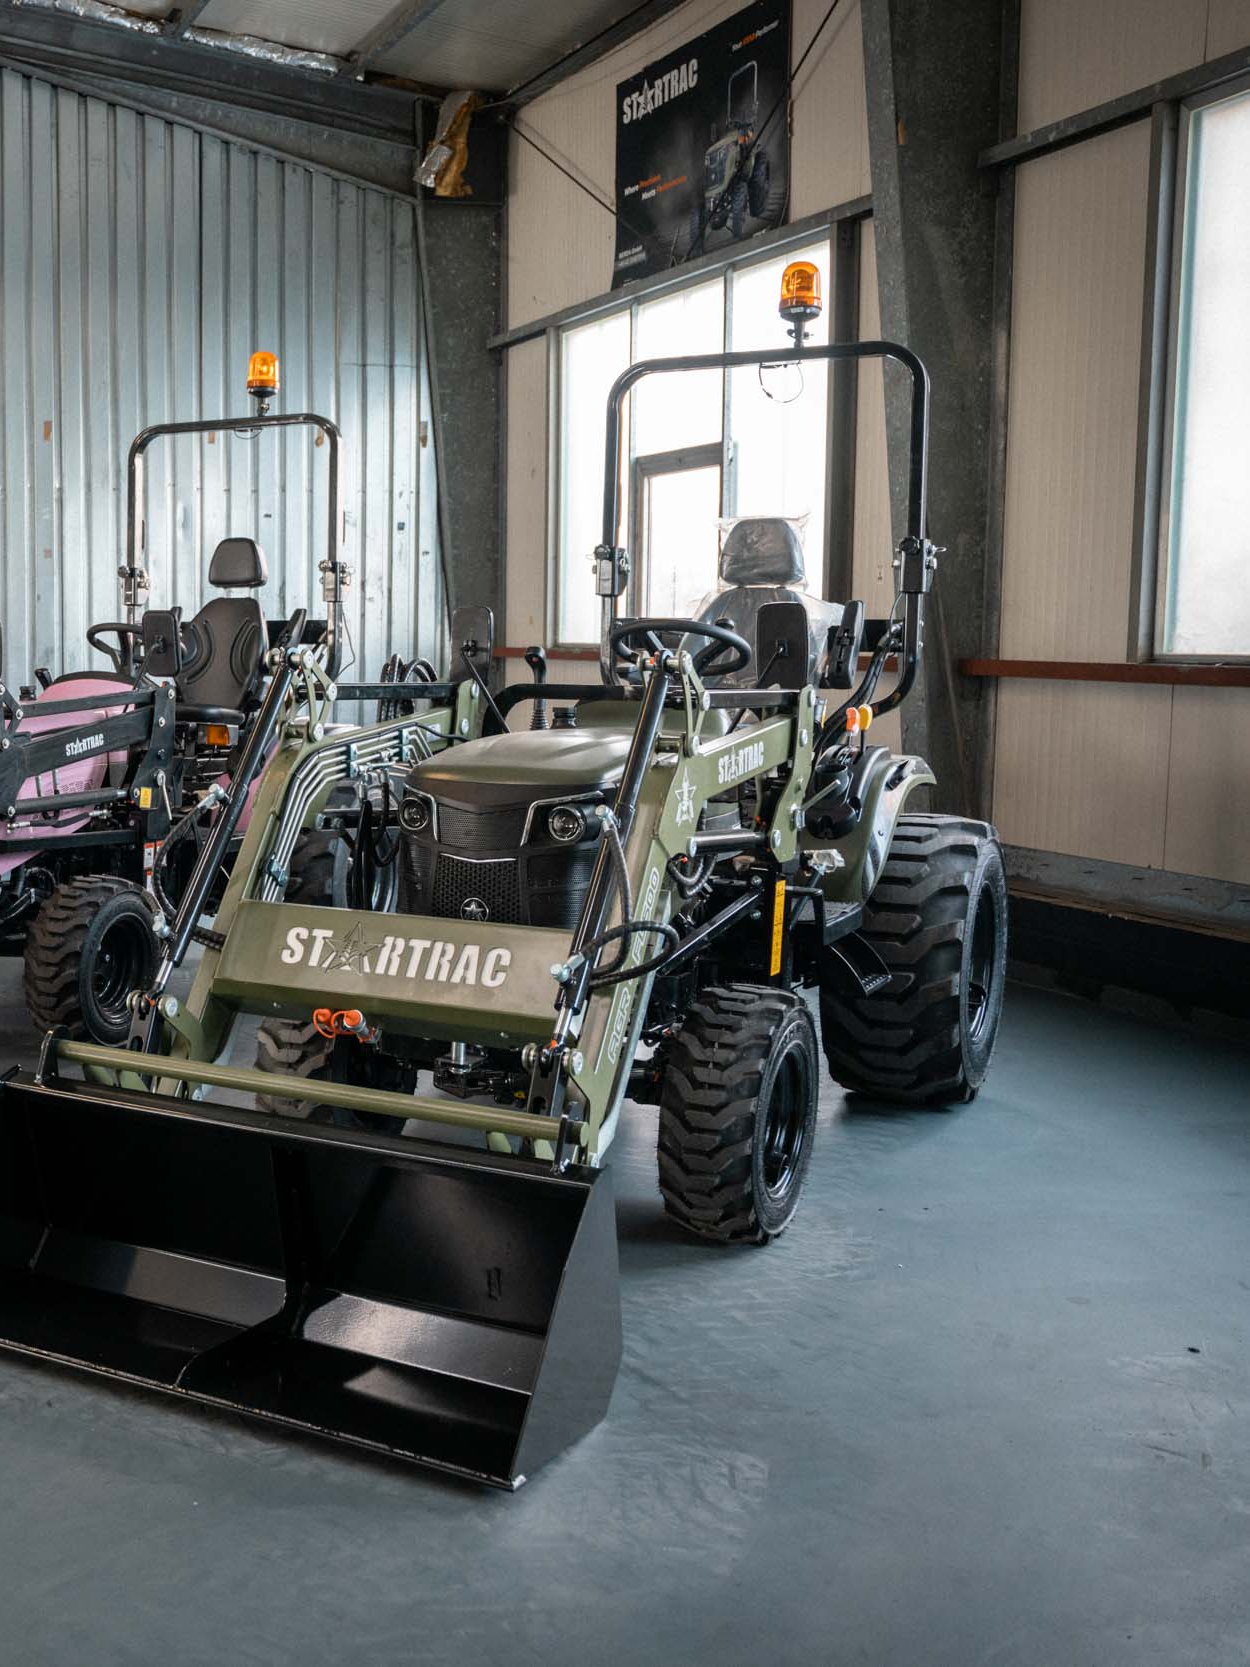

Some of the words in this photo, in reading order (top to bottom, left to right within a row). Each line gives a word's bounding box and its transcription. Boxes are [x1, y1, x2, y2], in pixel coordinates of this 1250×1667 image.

[622, 58, 699, 124] STARTRAC
[65, 733, 105, 757] STARTRAC
[717, 741, 765, 784] STARTRAC
[281, 920, 512, 988] STARTRAC
[607, 986, 631, 1065] AGR
